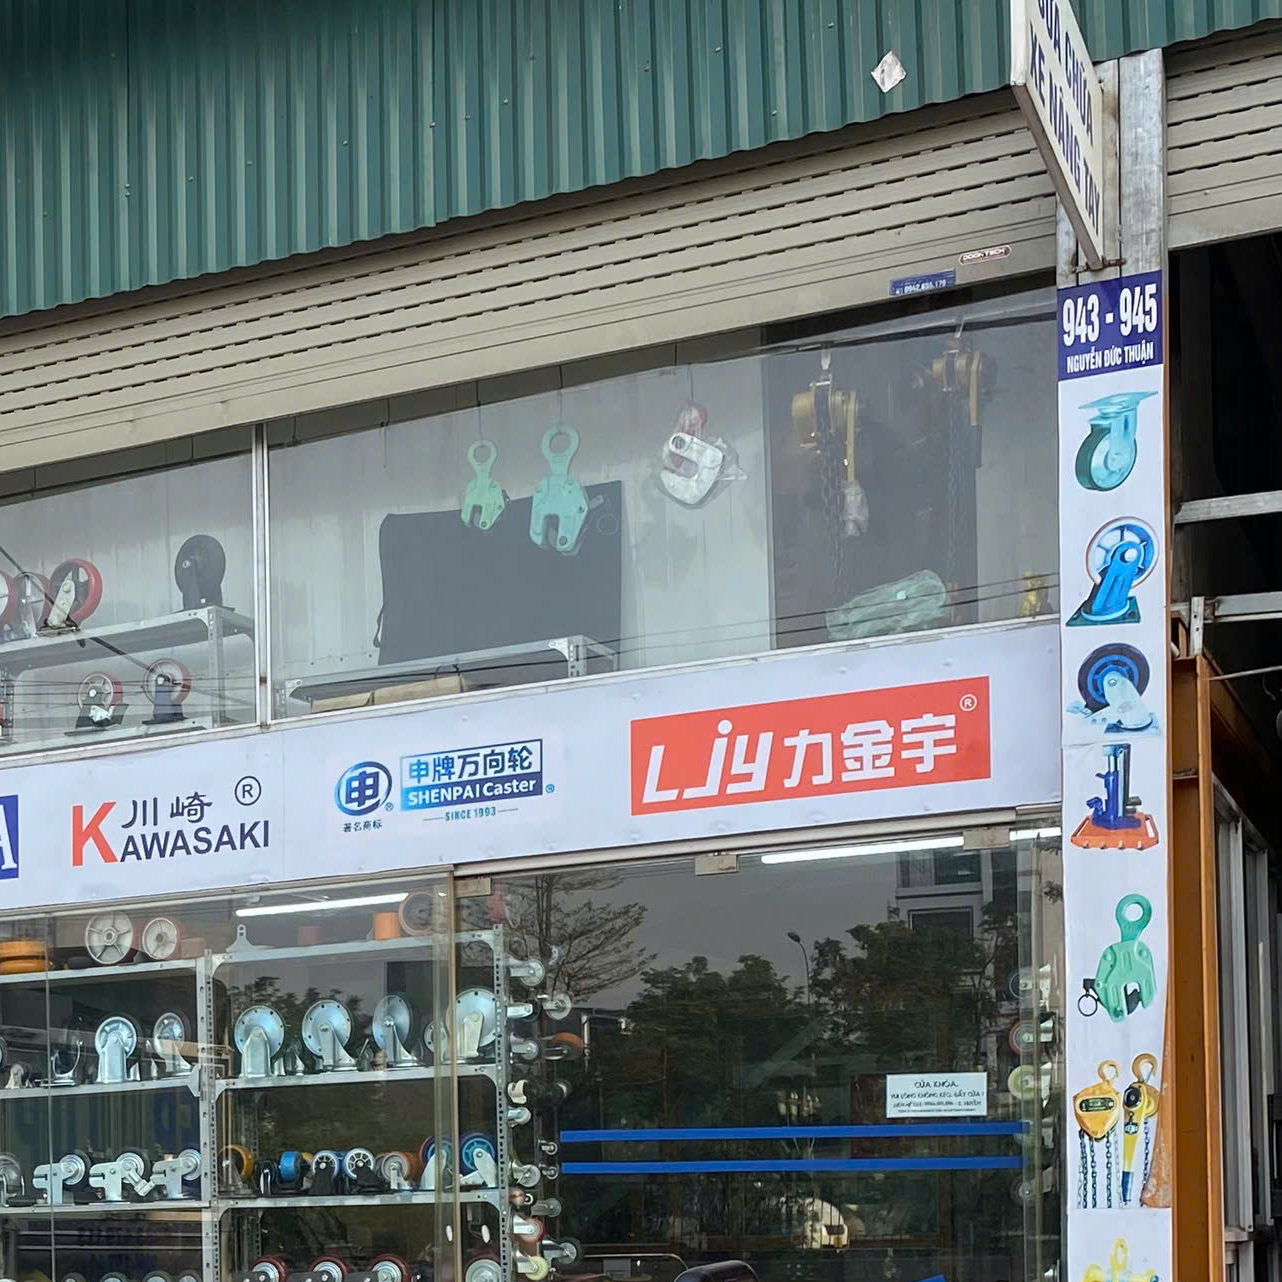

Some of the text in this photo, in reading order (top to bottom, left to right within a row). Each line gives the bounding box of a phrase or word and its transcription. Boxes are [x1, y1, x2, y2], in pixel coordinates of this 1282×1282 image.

[1030, 20, 1100, 236] XE NÂNG TAY
[1062, 294, 1099, 346] 943
[1119, 283, 1158, 336] 945
[1103, 345, 1122, 367] ĐỨC
[1124, 340, 1154, 365] THUẬN
[408, 745, 533, 783] 申牌万向轮
[783, 713, 957, 788] 力金宇
[121, 791, 214, 829] 川崎
[407, 778, 536, 806] SHENPAI Caster
[72, 794, 270, 867] KAWASAKI
[445, 809, 471, 821] SINCE
